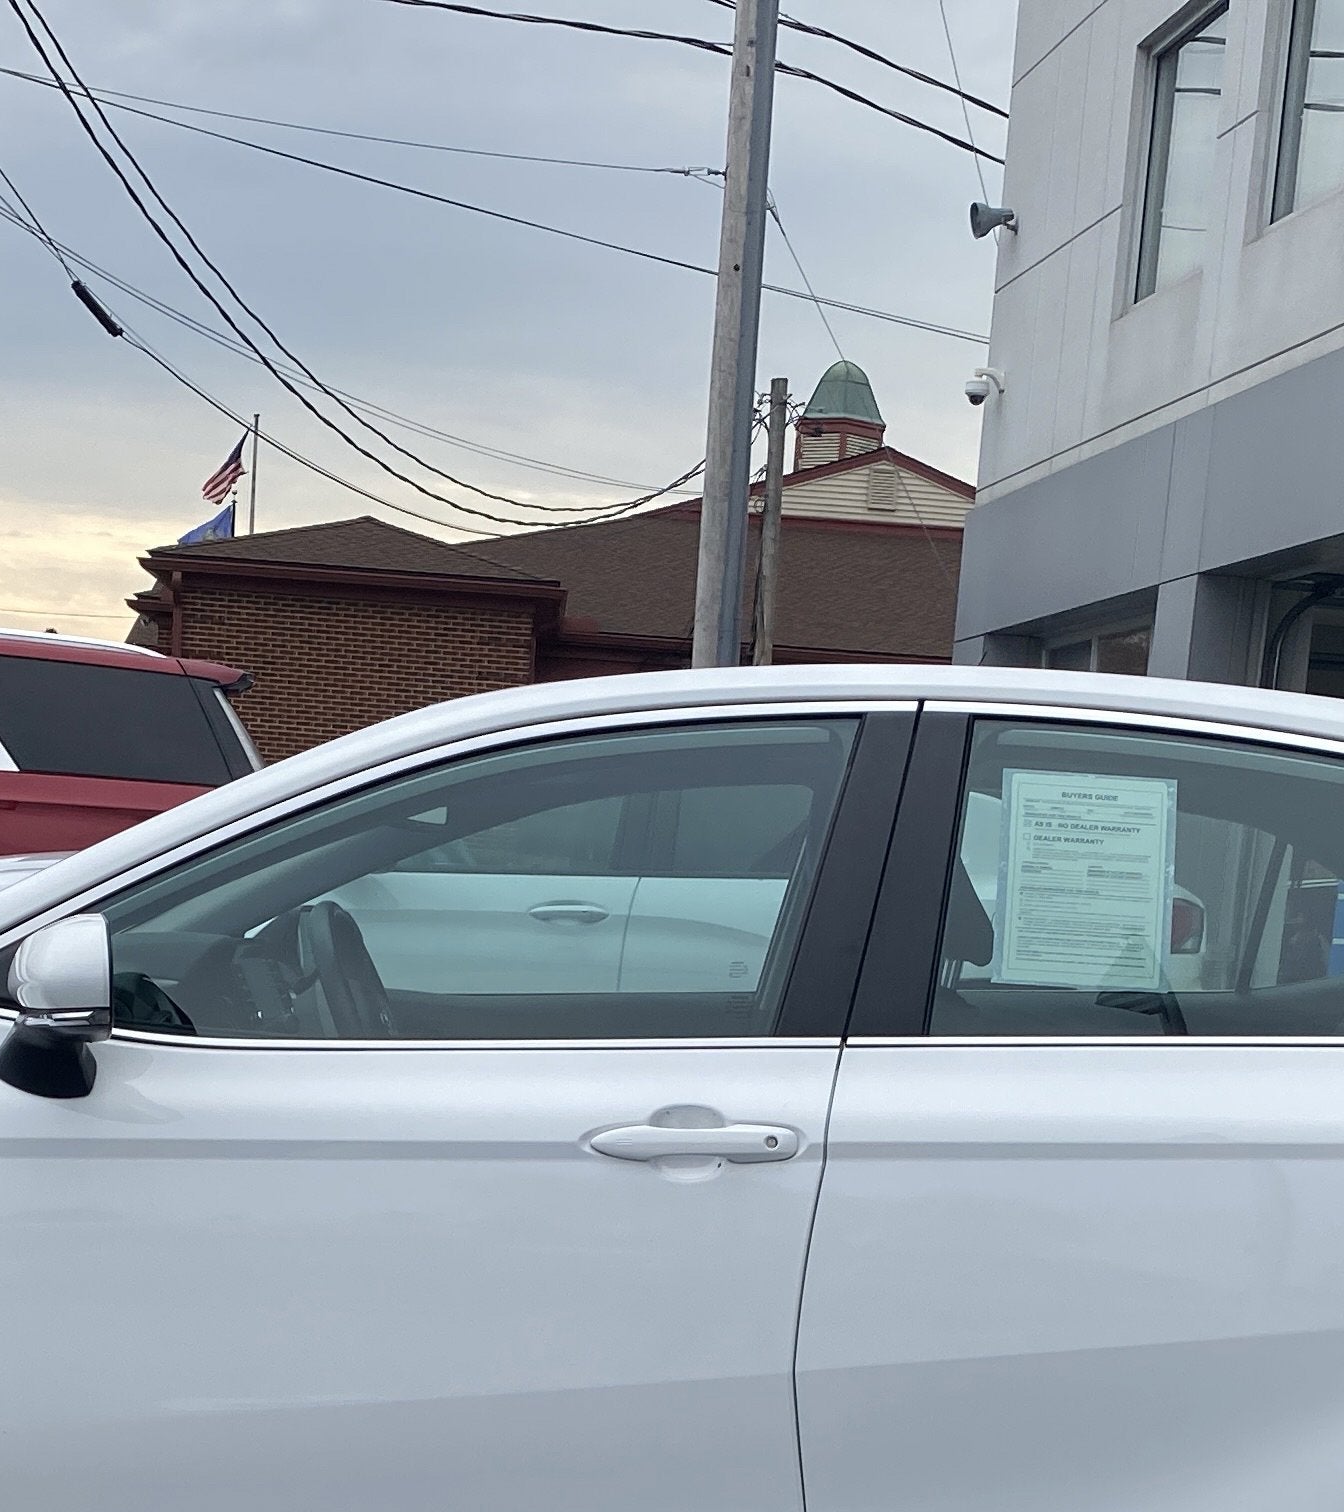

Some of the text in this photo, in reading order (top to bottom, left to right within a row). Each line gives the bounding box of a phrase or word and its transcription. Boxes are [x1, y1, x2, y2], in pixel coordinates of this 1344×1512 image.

[1061, 791, 1119, 802] BUYERS GUIDE
[1070, 823, 1099, 831] DEALER
[1100, 825, 1141, 834] WARRANTY
[1033, 834, 1062, 843] DEALER
[1063, 835, 1105, 845] WARRANTY
